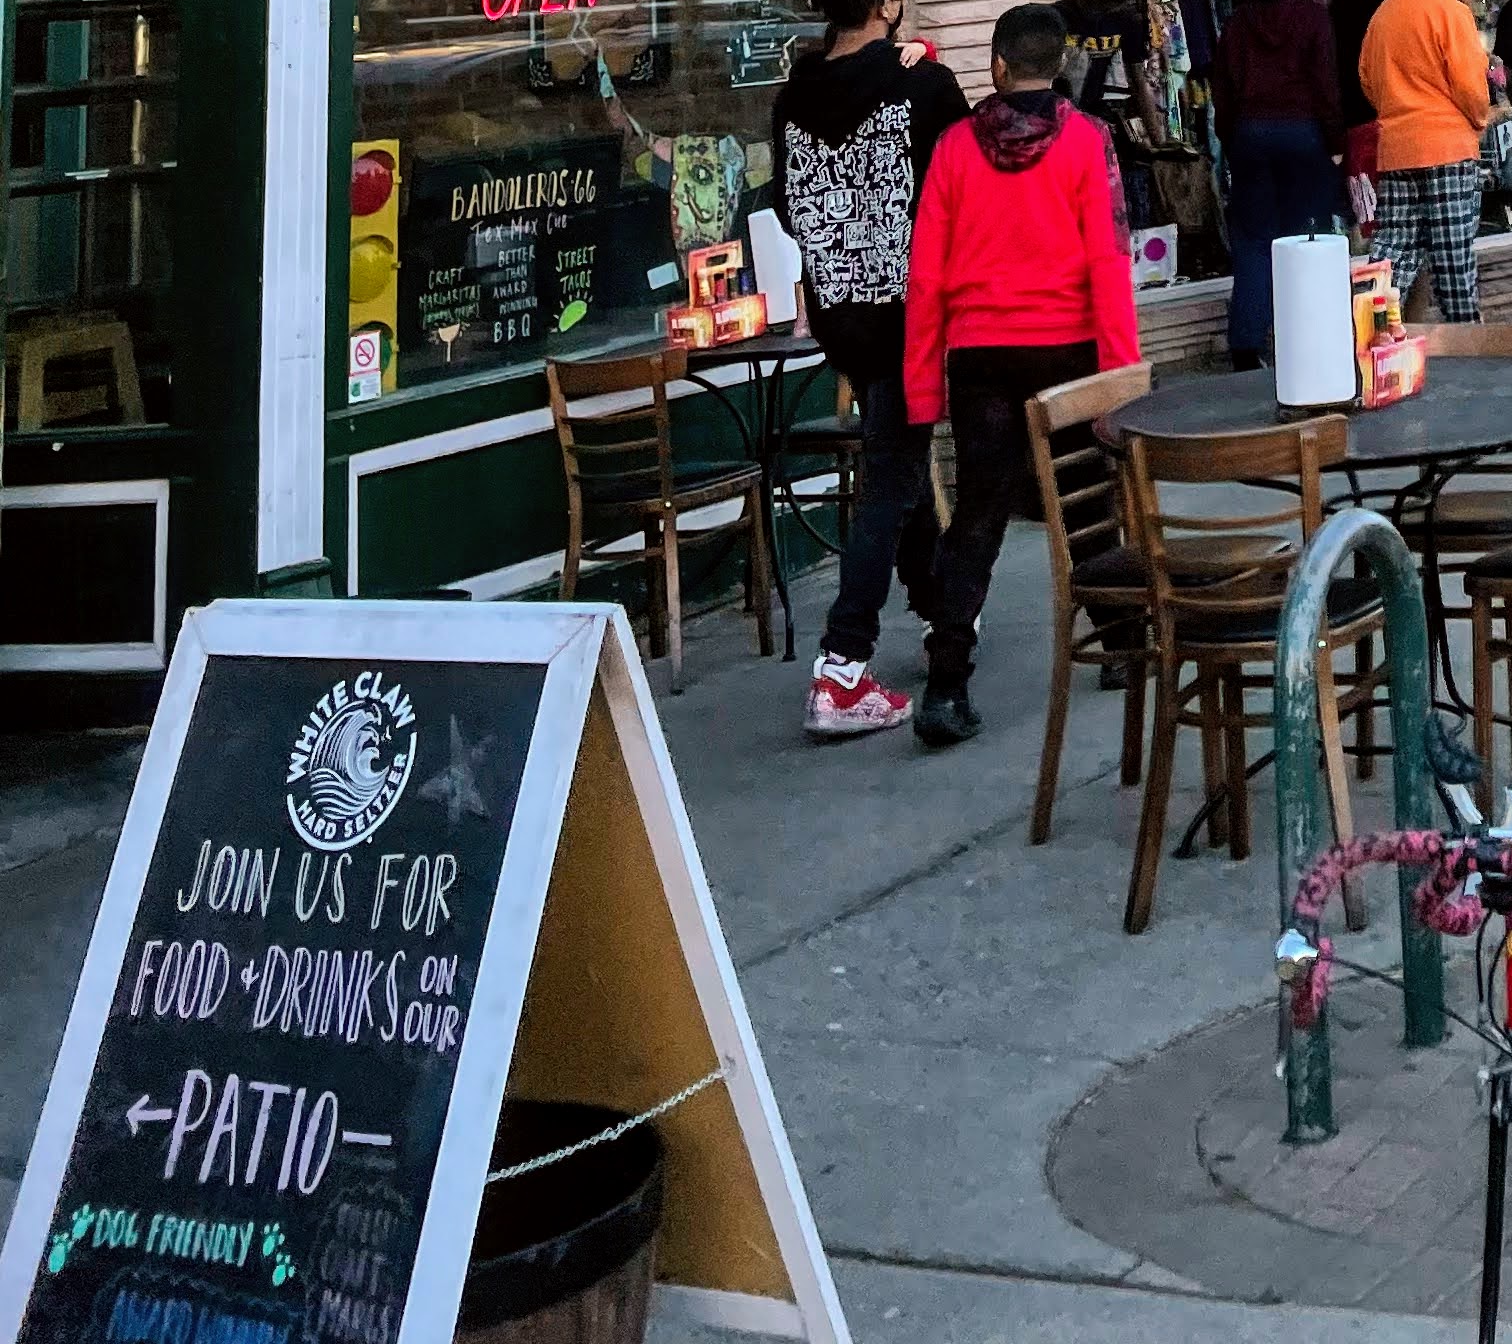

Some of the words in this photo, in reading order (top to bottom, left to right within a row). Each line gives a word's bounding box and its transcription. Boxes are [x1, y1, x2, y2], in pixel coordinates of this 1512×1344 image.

[428, 266, 464, 290] CRAFT
[498, 245, 536, 267] BETTER
[556, 245, 597, 272] STREET
[560, 269, 592, 294] TACOS
[286, 680, 349, 784] WHITE
[354, 671, 416, 729] CLAW
[297, 799, 337, 839] HARD
[344, 753, 407, 837] SELTZER
[177, 840, 281, 918] JOIN
[295, 852, 352, 923] US
[370, 853, 458, 936] FOR
[131, 940, 230, 1016] FOOD
[253, 945, 406, 1044] DRINKS
[419, 954, 458, 996] ON
[403, 1001, 461, 1052] OUR
[163, 1069, 339, 1195] PATIO
[92, 1208, 139, 1248] DOG
[145, 1212, 255, 1267] FRIENDLY
